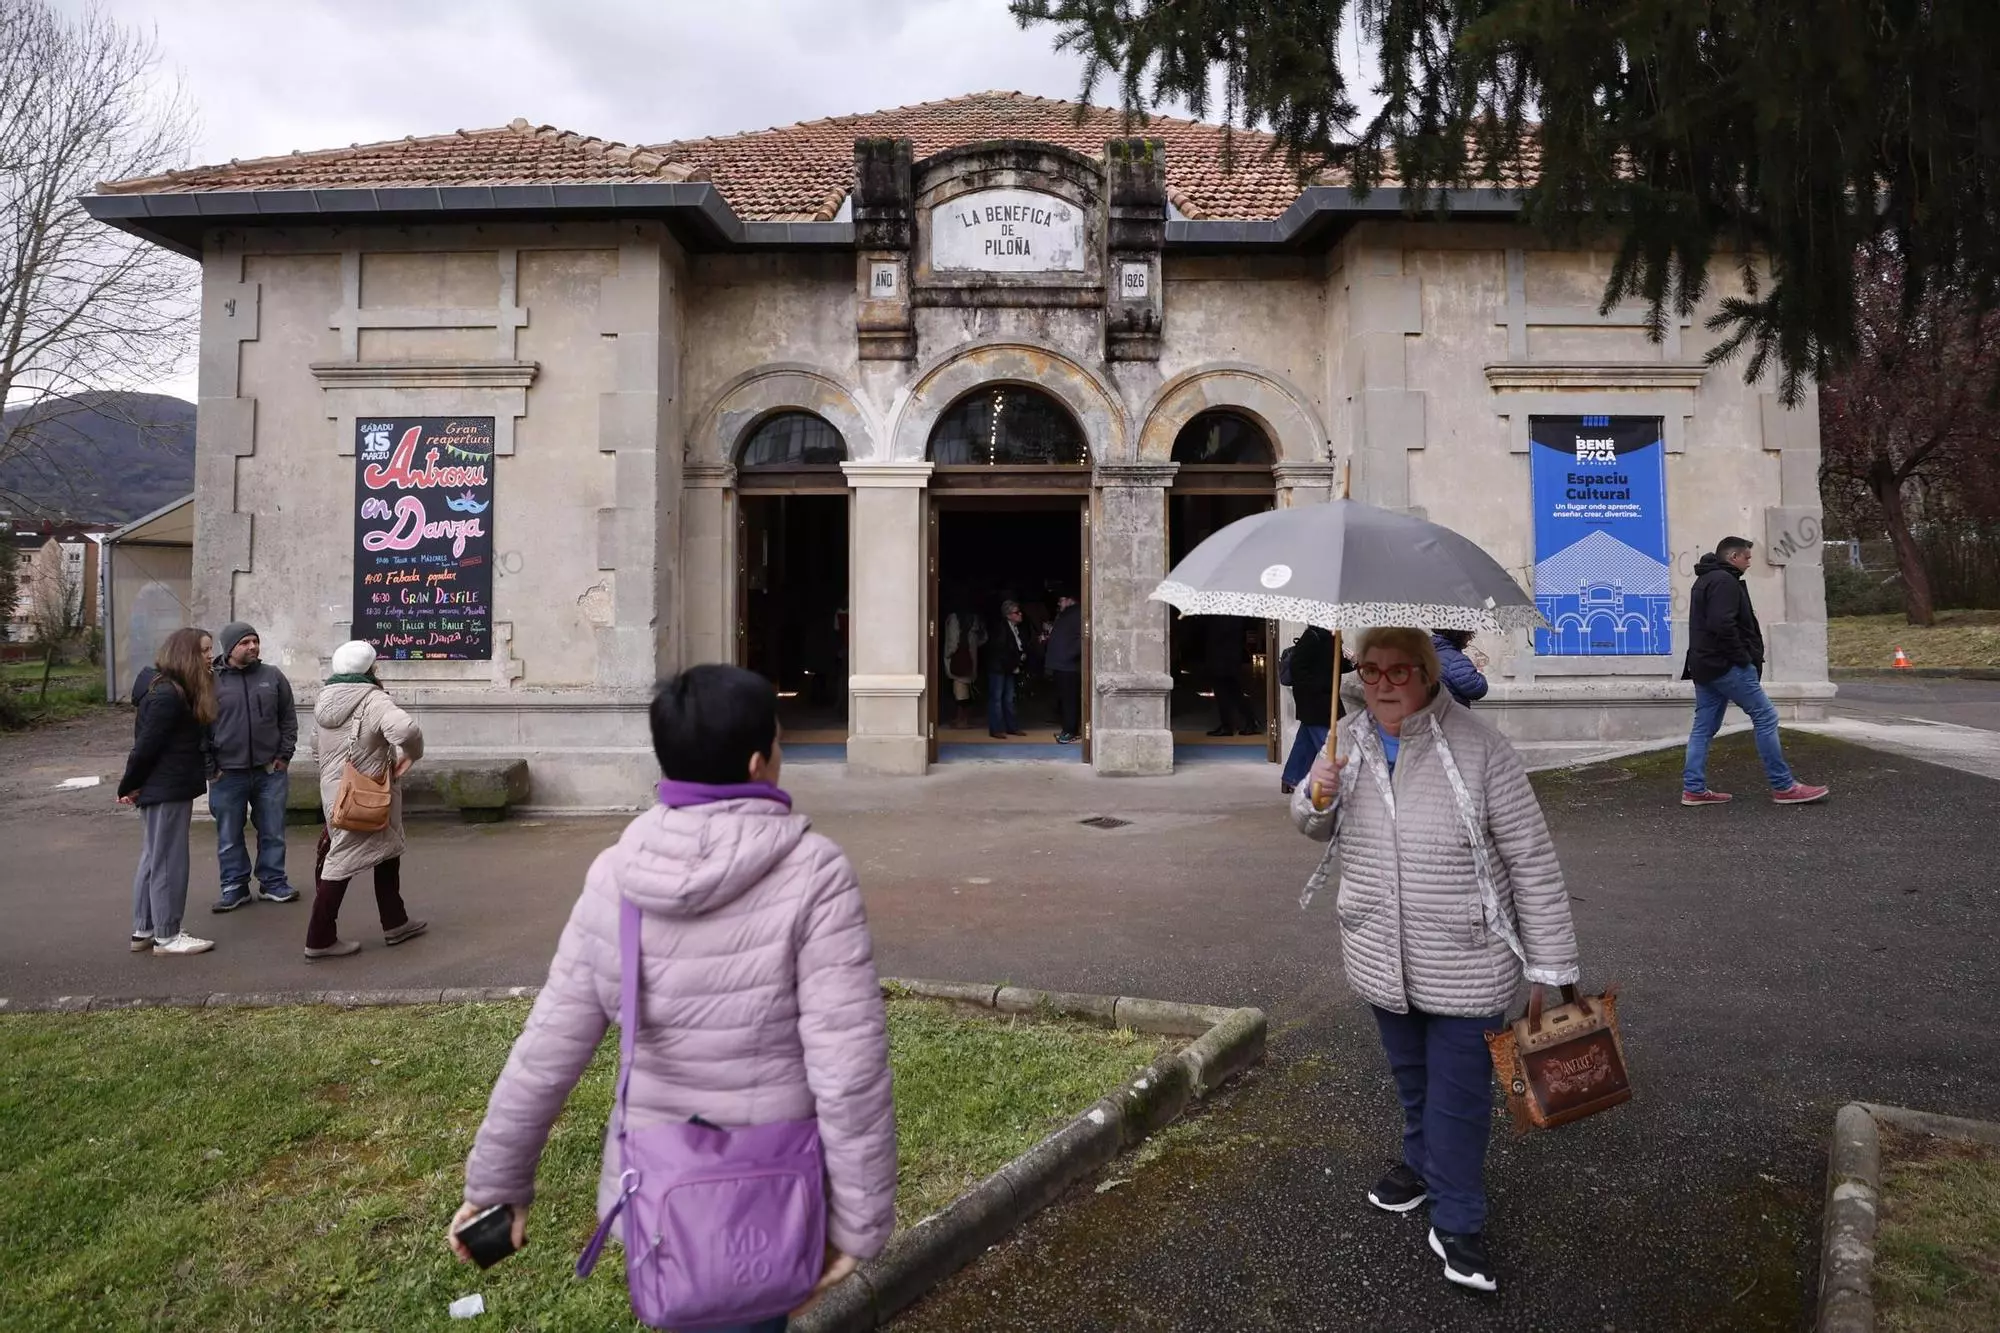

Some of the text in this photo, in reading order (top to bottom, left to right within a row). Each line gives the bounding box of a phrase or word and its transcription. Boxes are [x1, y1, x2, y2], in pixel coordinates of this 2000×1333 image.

[1001, 224, 1015, 237] DE
[985, 237, 1031, 256] PILOÑA
[875, 270, 893, 288] AÑO
[1124, 273, 1145, 288] 1926
[360, 423, 394, 433] SÁBADU
[446, 422, 478, 434] Gran
[364, 431, 391, 452] 15
[426, 434, 490, 447] reapertura
[361, 451, 390, 460] MARZU
[364, 426, 488, 490] Antroxu
[1567, 472, 1628, 487] Espaciu
[1566, 487, 1631, 500] Cultural
[361, 497, 392, 520] en
[1553, 510, 1583, 518] enseñar,
[1567, 503, 1587, 511] llugar
[1607, 503, 1642, 511] aprender,
[363, 495, 485, 558] Danza
[386, 568, 420, 585] Fabada
[426, 568, 457, 586] popular
[401, 588, 430, 604] GRAN
[427, 631, 461, 647] Danza
